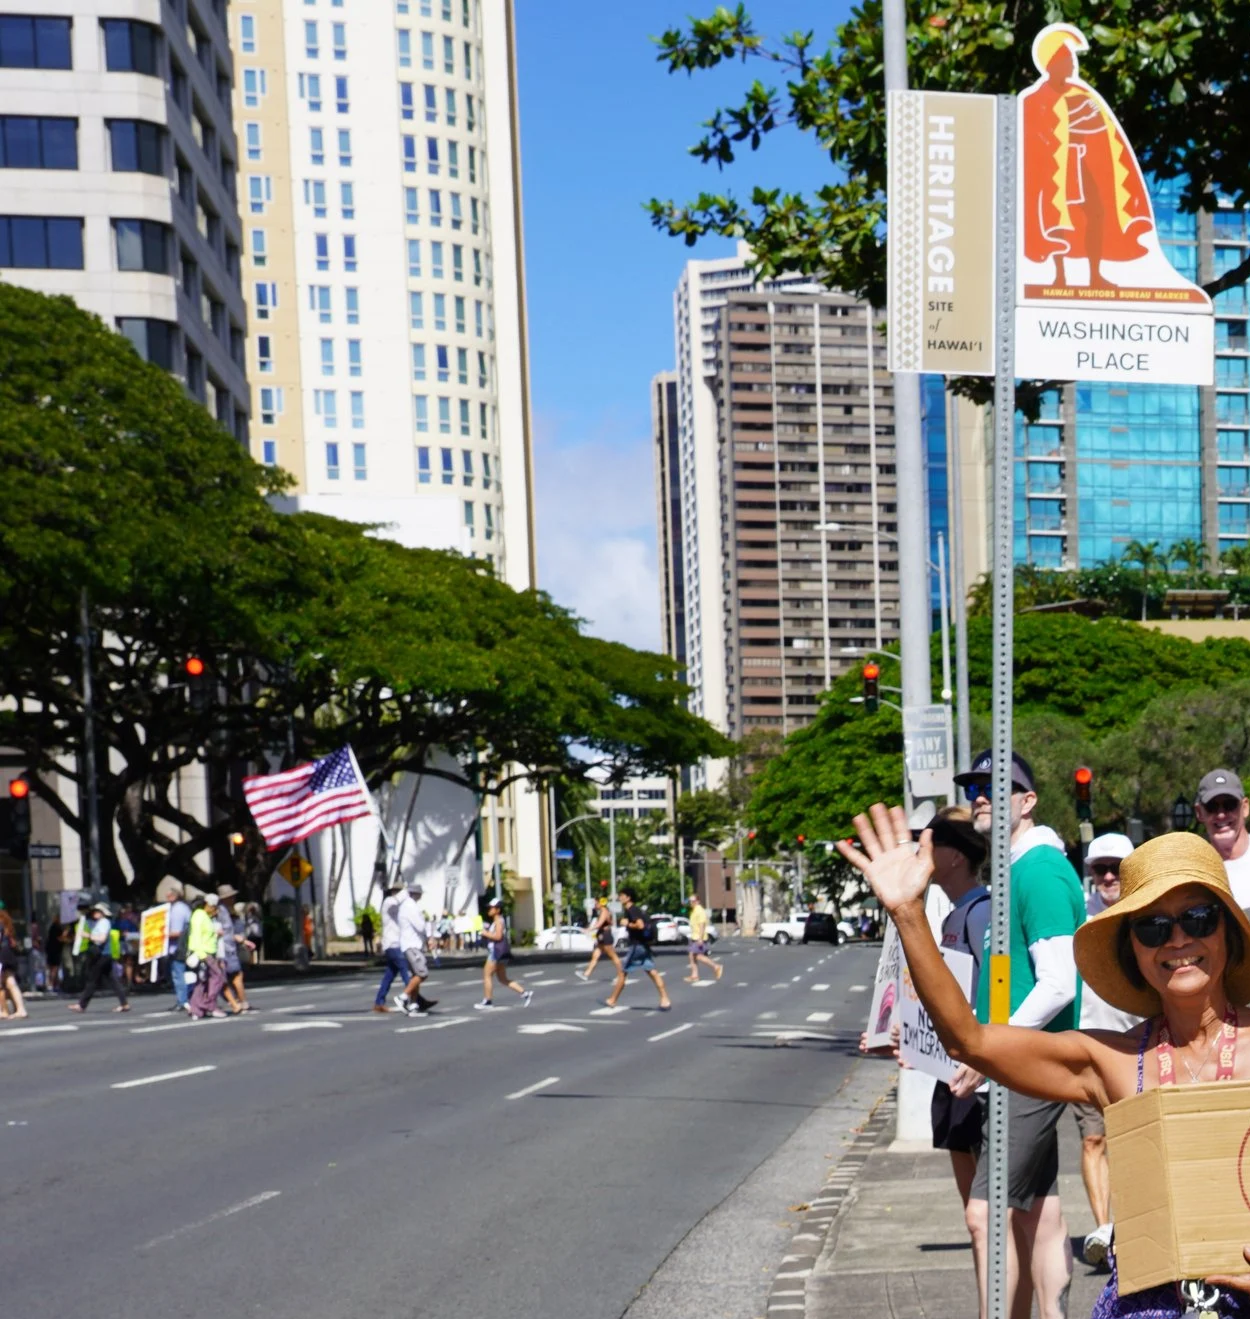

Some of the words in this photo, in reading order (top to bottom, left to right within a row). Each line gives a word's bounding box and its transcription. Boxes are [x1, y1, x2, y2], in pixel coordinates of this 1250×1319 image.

[928, 115, 955, 293] HERITAGE
[1043, 288, 1074, 297] HAWAII
[1078, 289, 1116, 298] VISITORS
[1119, 290, 1151, 299] BUREAU
[1154, 291, 1190, 300] MARKER
[928, 300, 954, 312] SITE
[928, 317, 943, 333] of
[1038, 319, 1190, 343] WASHINGTON
[1076, 351, 1150, 371] PLACE
[916, 735, 942, 752] ANY
[916, 753, 945, 769] TIME
[1158, 1052, 1172, 1077] USC
[1220, 1043, 1235, 1068] USC
